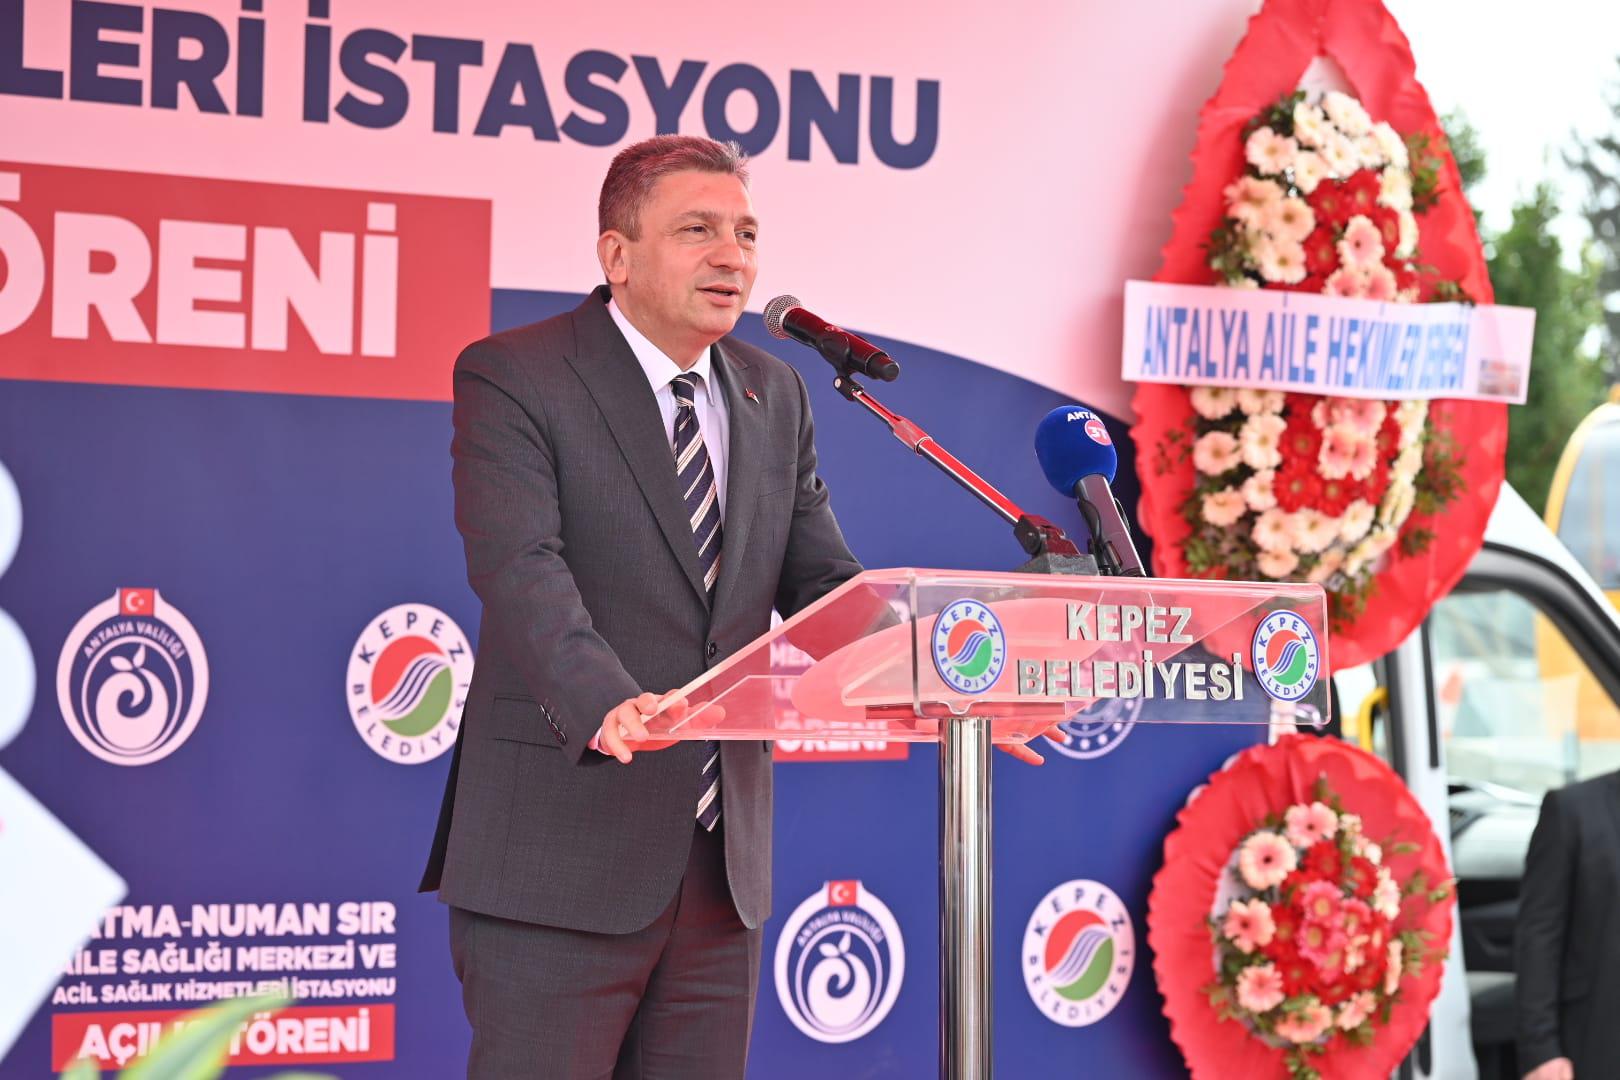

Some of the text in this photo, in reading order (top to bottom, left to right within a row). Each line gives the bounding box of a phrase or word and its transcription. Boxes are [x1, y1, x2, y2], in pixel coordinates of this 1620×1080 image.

[303, 0, 940, 170] İSTASYONU
[1141, 305, 1250, 379] ANTALYA
[1259, 293, 1320, 383] AİLE
[84, 621, 135, 659] ANTALYA
[358, 611, 465, 664] KEPEZ
[941, 606, 998, 637] KEPEZ
[1067, 603, 1193, 643] KEPEZ
[1258, 617, 1311, 648] KEPEZ
[1018, 650, 1244, 700] BELEDİYESİ
[90, 901, 396, 939] TMA-NUMAN SIR
[122, 941, 231, 974] SAĞLIĞI
[236, 939, 355, 972] MERKEZİ
[359, 943, 397, 970] VE
[52, 982, 98, 1004] ACİL
[101, 980, 173, 1003] SAĞLIK
[292, 976, 396, 999] İSTASYONU
